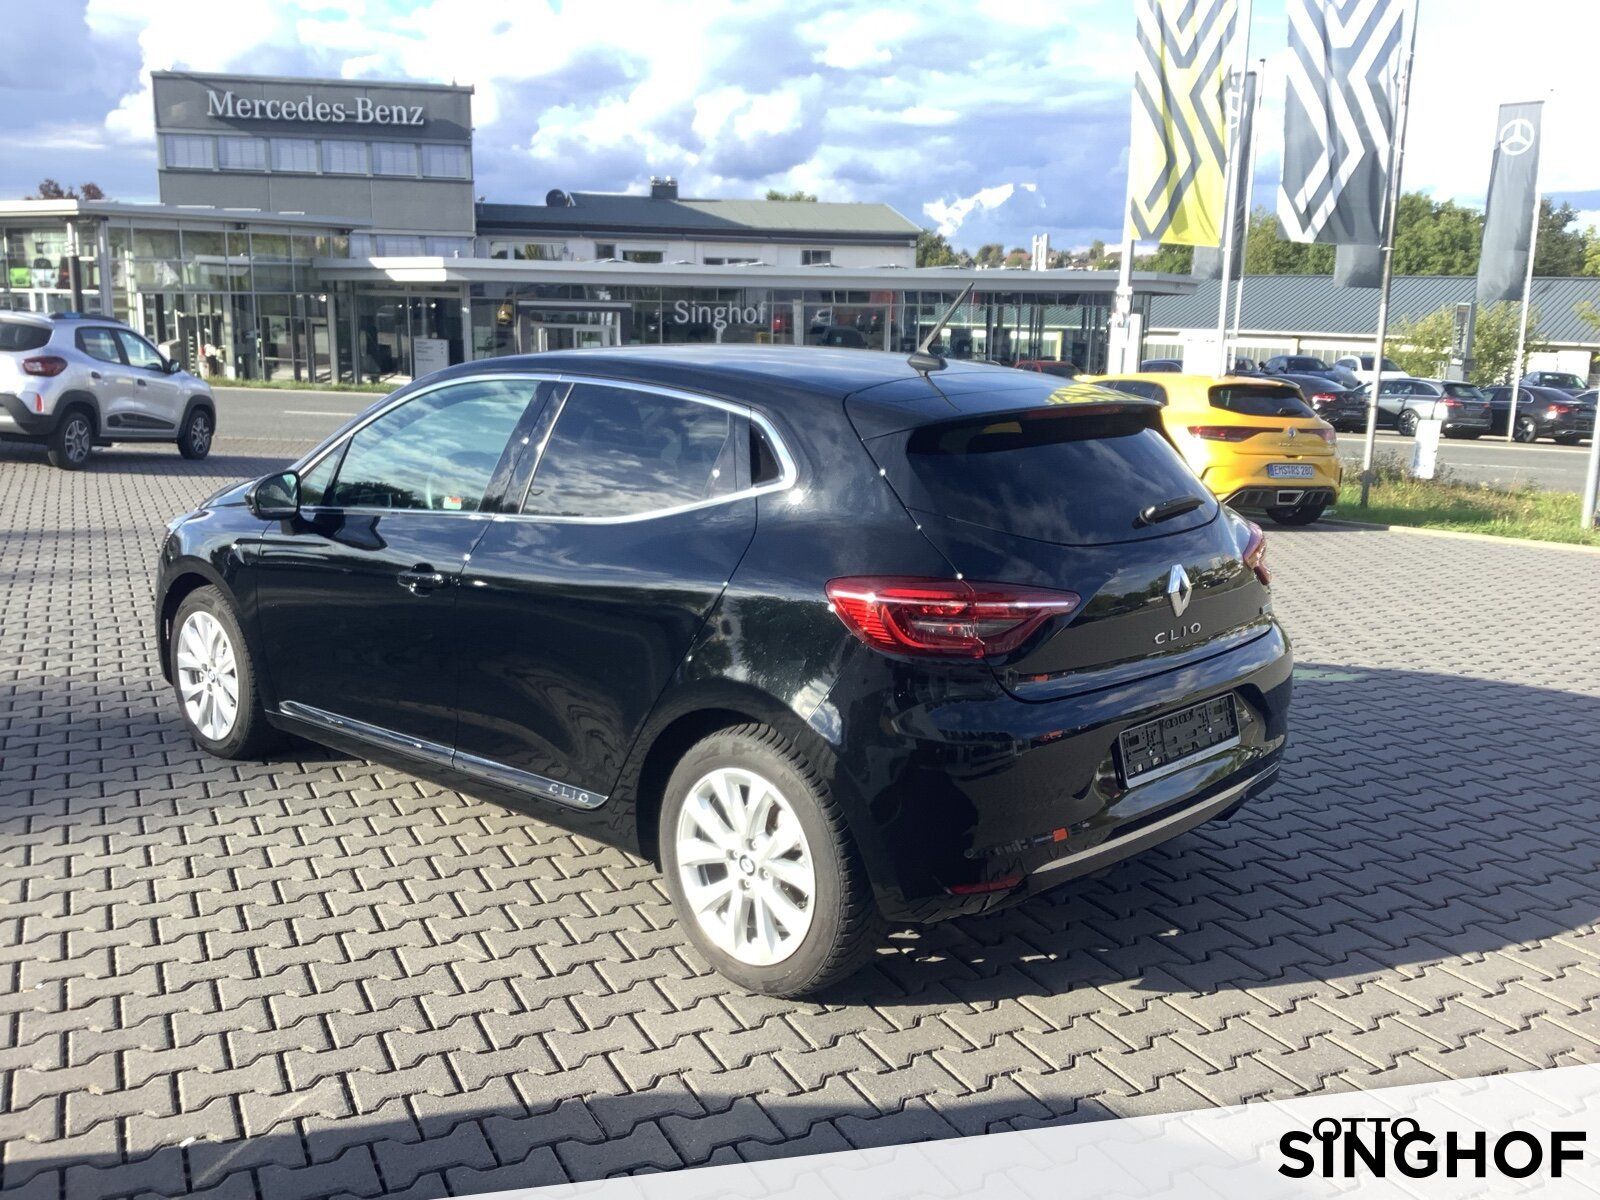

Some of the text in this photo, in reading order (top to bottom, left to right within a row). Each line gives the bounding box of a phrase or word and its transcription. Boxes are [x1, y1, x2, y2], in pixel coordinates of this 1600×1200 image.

[206, 90, 425, 126] Mercedes-Benz
[674, 300, 767, 330] Singhof
[1154, 622, 1201, 645] CLIO
[549, 783, 589, 803] CLIO
